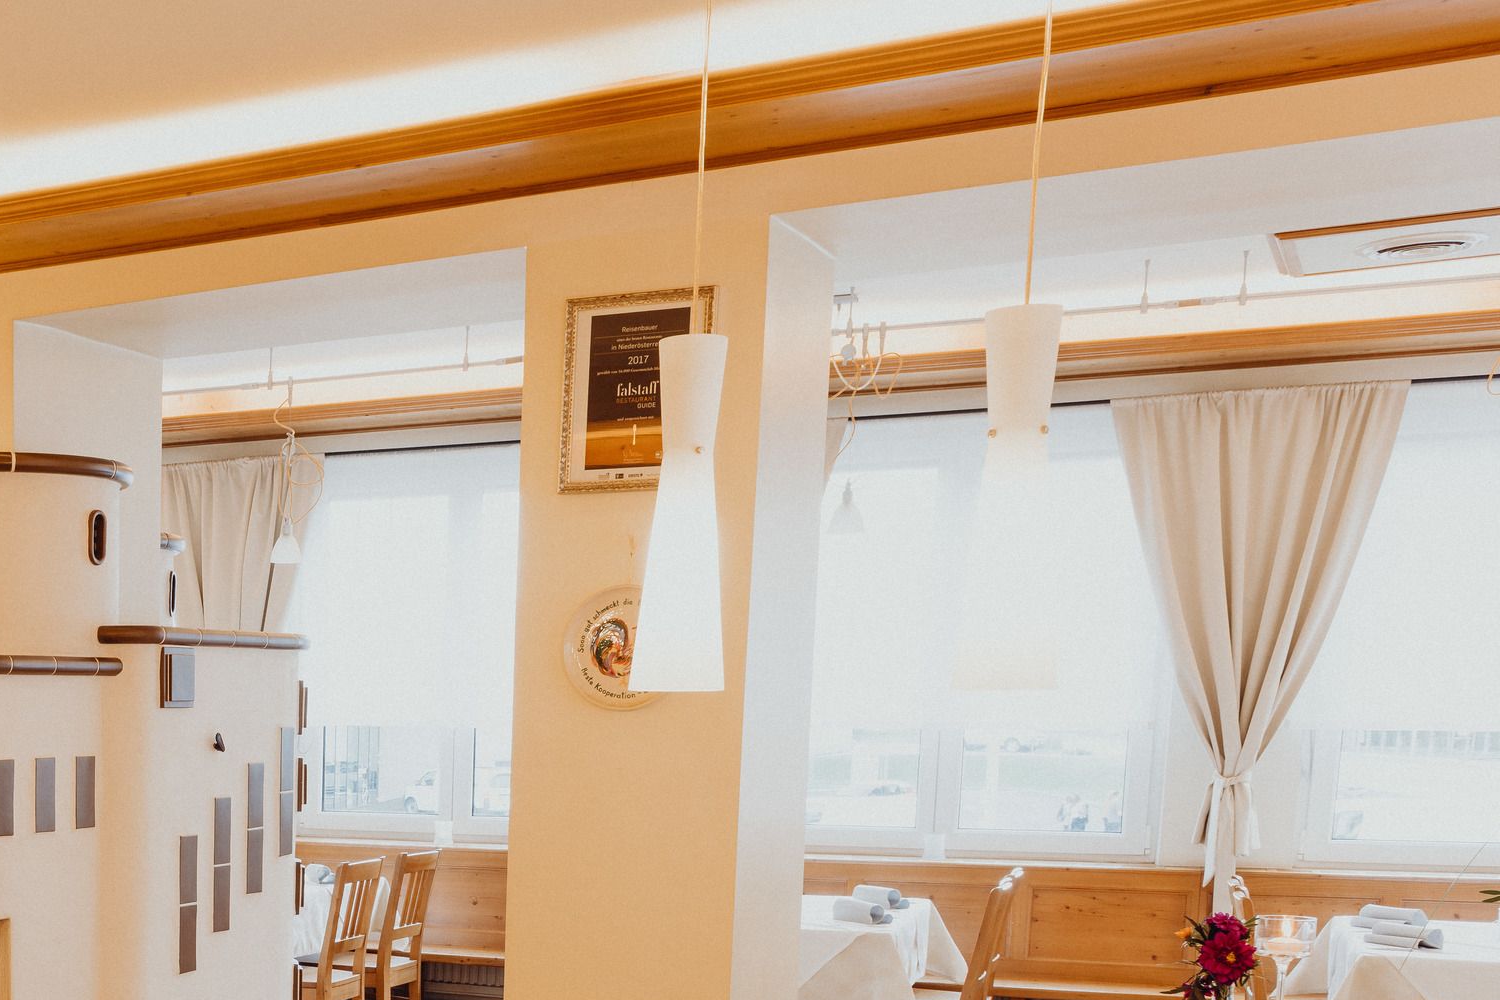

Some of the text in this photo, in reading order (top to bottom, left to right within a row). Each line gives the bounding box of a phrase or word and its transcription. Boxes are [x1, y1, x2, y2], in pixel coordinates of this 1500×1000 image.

[622, 325, 658, 333] Reisenbauer
[618, 342, 659, 350] Niederösterre
[627, 354, 650, 365] 2017
[617, 380, 660, 396] falstaff
[584, 620, 593, 633] gut
[592, 600, 620, 621] schmeckt
[594, 682, 636, 699] Kooperation
